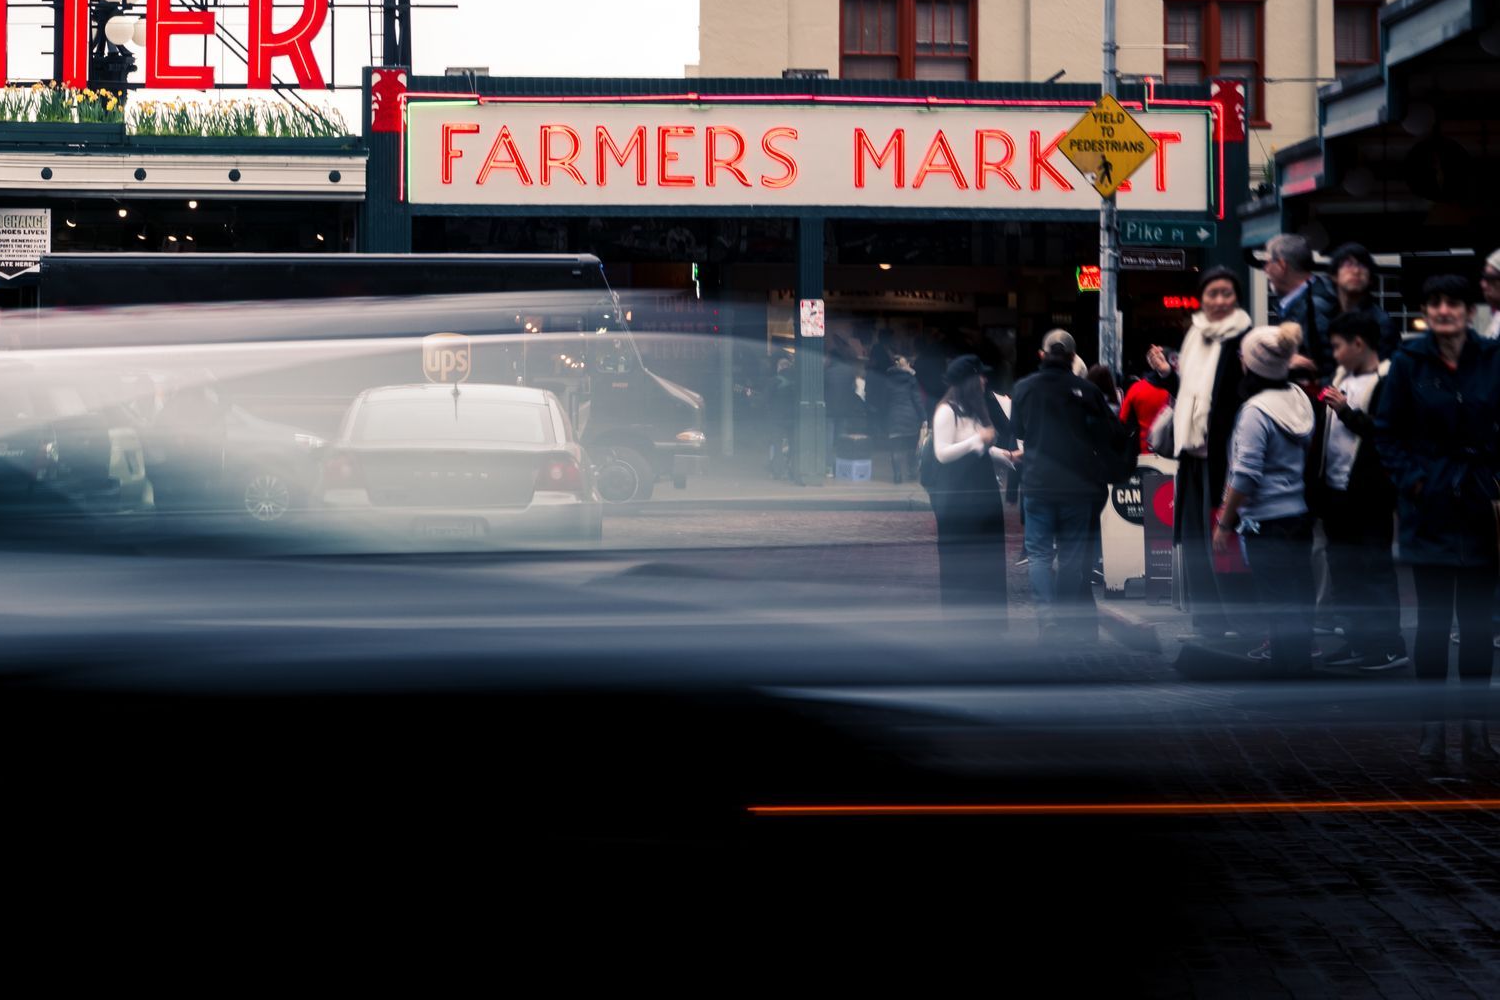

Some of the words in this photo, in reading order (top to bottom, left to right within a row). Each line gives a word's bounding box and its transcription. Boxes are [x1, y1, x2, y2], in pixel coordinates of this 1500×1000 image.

[1092, 111, 1125, 124] YIELD
[1100, 126, 1114, 137] TO
[1069, 139, 1145, 153] PEDESTRIANS
[440, 123, 798, 189] FARMERS
[854, 127, 1182, 192] MARKT
[4, 214, 48, 229] CHANGE
[1126, 221, 1163, 241] Pike
[1172, 230, 1184, 241] Pl
[426, 350, 467, 381] ups
